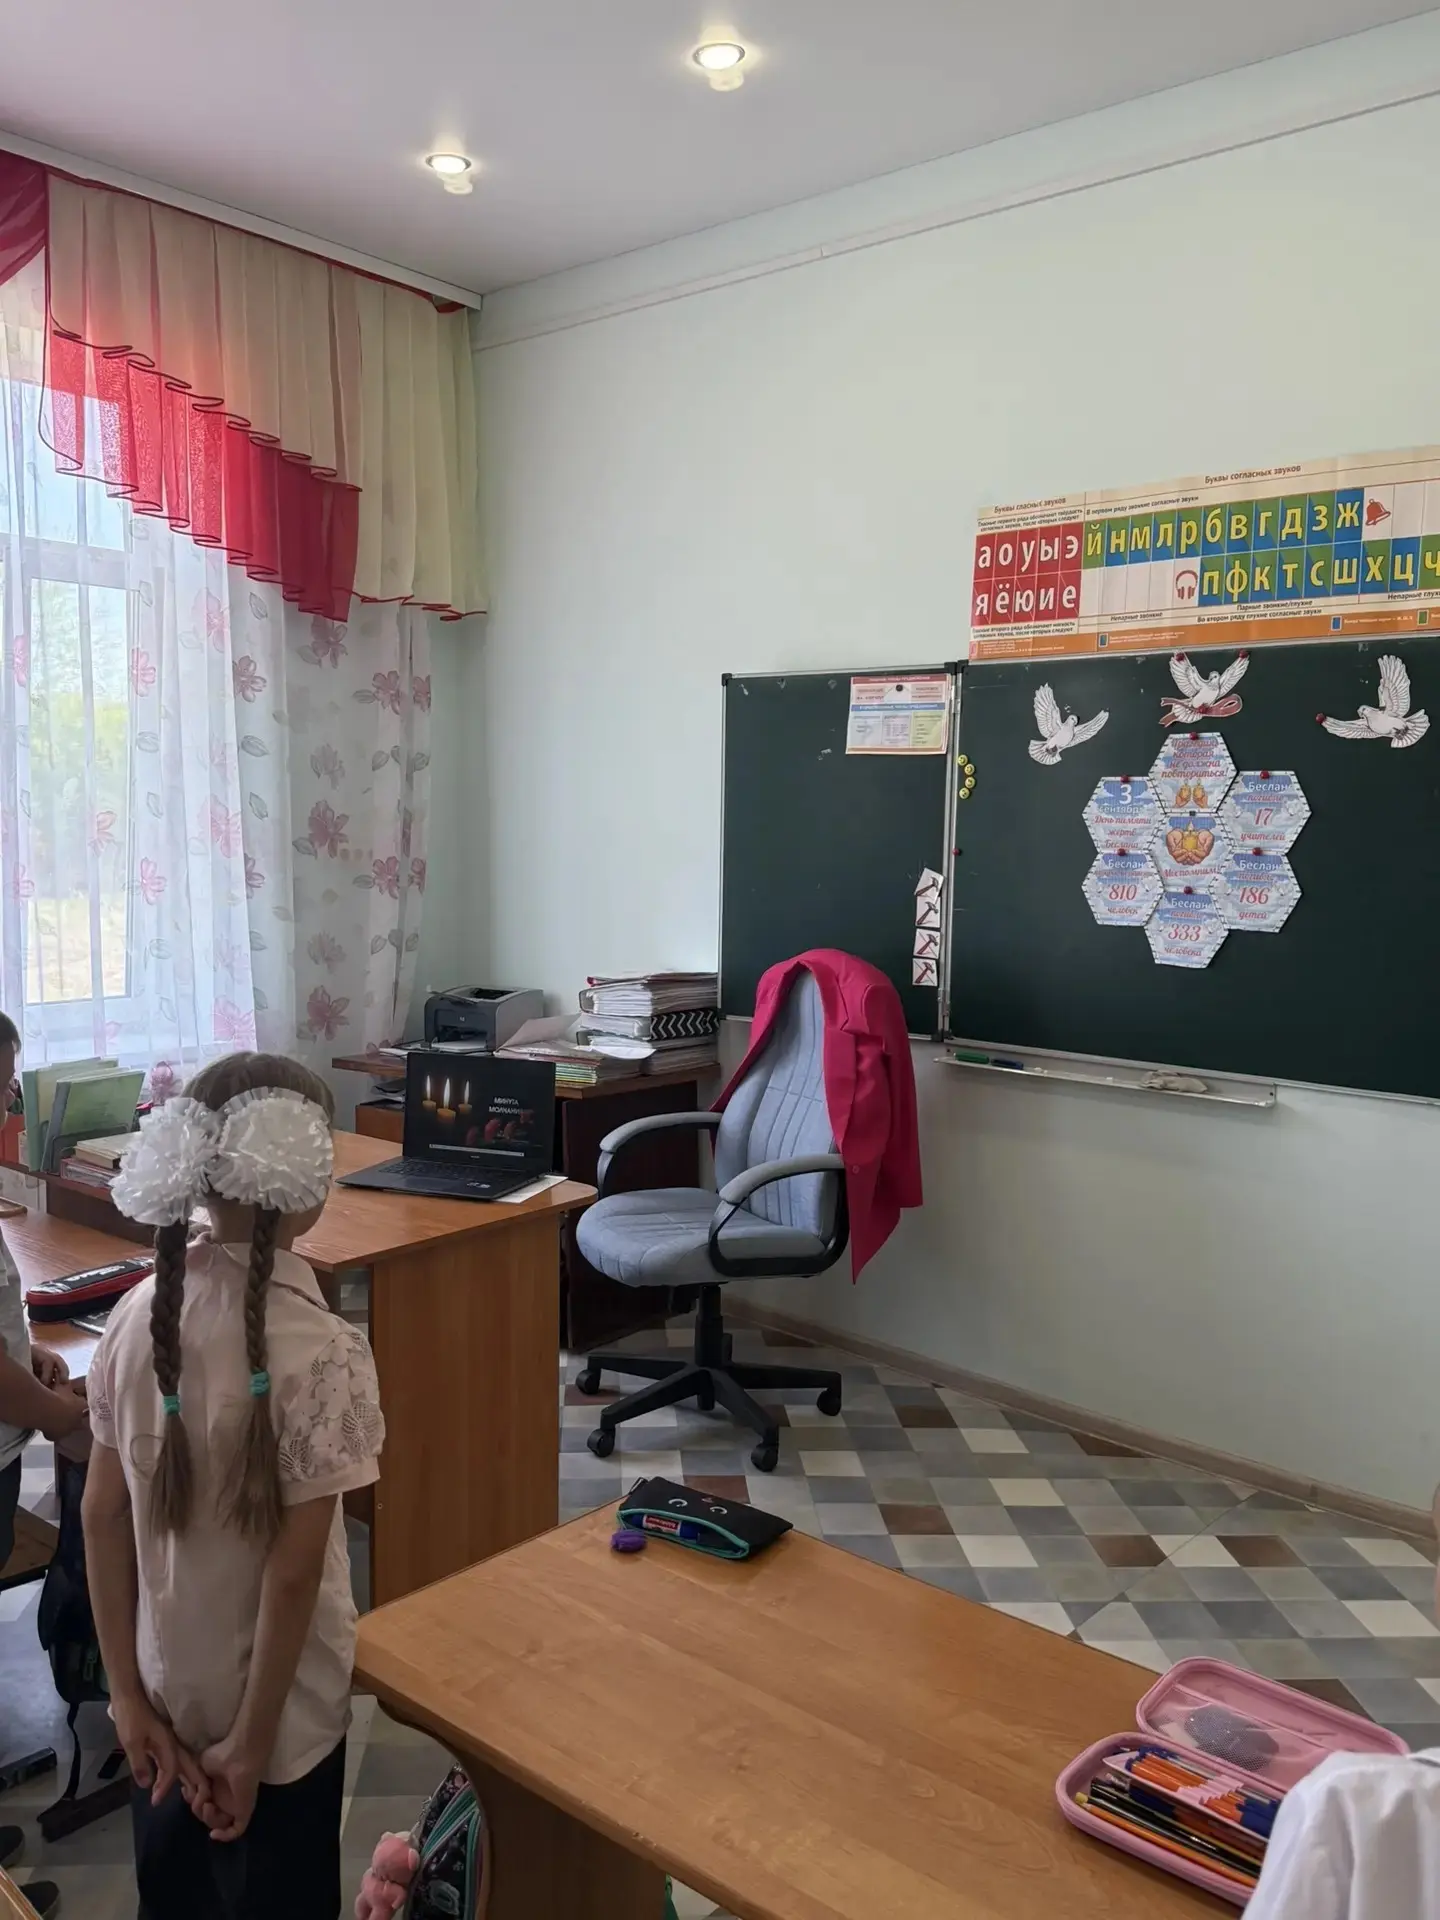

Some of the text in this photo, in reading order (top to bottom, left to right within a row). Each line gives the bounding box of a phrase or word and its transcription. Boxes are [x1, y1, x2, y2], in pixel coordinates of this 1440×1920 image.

[1204, 465, 1301, 484] Буквы согласных звуков
[994, 498, 1066, 514] Буквы гласных звуков
[1387, 592, 1422, 601] Непарные
[1236, 604, 1262, 612] Парные
[1110, 614, 1139, 622] Непарные
[1161, 767, 1229, 779] повториться!
[1119, 784, 1132, 804] 3
[1255, 807, 1273, 825] 17
[1240, 832, 1286, 842] учителей
[1109, 884, 1137, 901] 810
[1239, 887, 1270, 905] 186
[1239, 911, 1268, 920] детей
[1168, 923, 1201, 941] 333
